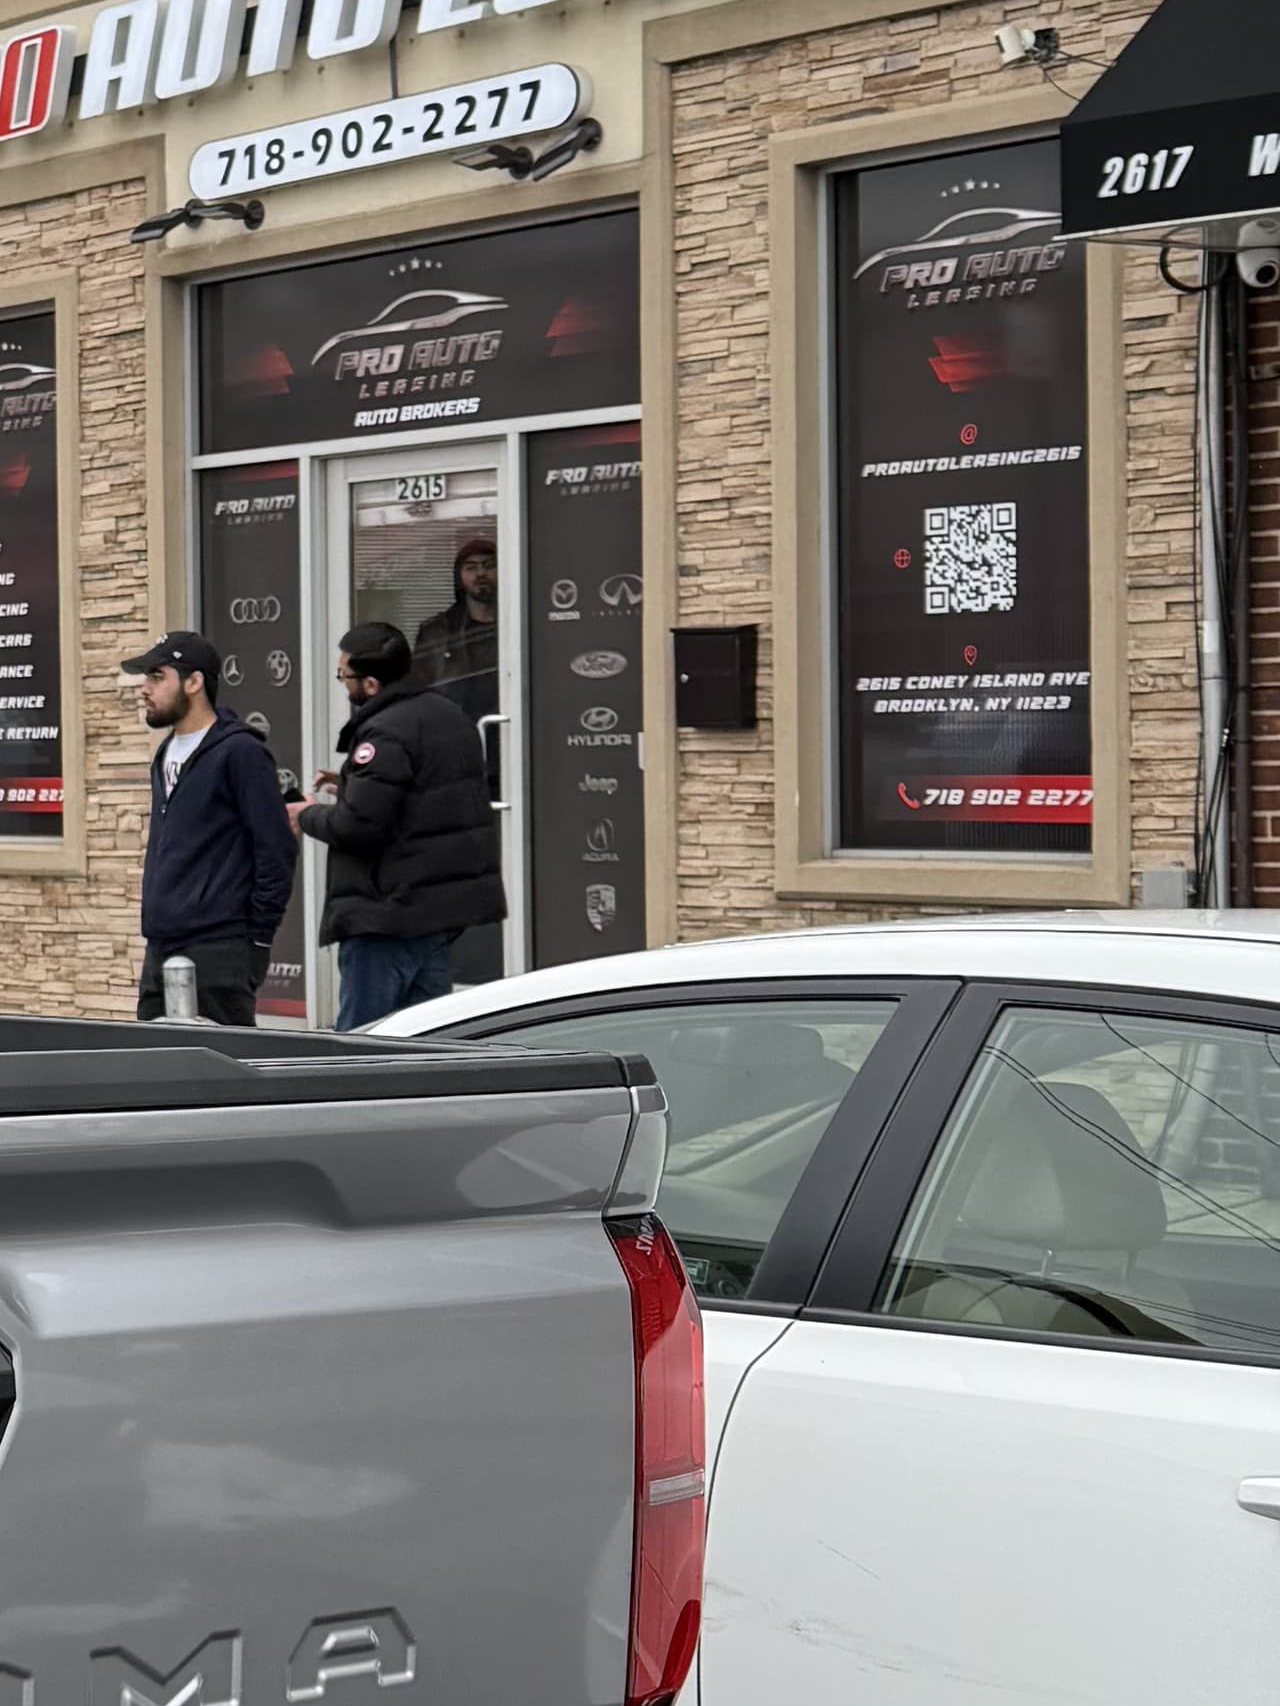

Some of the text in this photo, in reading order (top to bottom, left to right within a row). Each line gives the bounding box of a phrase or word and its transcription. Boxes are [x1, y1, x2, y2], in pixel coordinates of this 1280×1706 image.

[217, 80, 543, 187] 718-902-2277
[1096, 144, 1194, 199] 2617
[880, 242, 1068, 293] PRO AUTO
[907, 277, 1040, 310] LEASING
[335, 329, 503, 381] PRO AUTO
[353, 396, 481, 428] AUTO BROKERS
[959, 423, 978, 445] @
[861, 444, 1083, 478] PROAUTOLEASING2615
[545, 465, 588, 486] PRO
[397, 475, 443, 501] 2615
[215, 494, 296, 516] PRO AUTO
[856, 671, 1090, 692] 2615 CONEY ISLAND AVE
[986, 697, 1010, 712] NY
[1015, 695, 1072, 711] 11223
[6, 726, 59, 740] RETURN
[567, 733, 632, 746] HYUNDAI
[578, 773, 618, 794] Jeep
[7, 788, 36, 802] 902
[923, 789, 1093, 806] 718 902 2277
